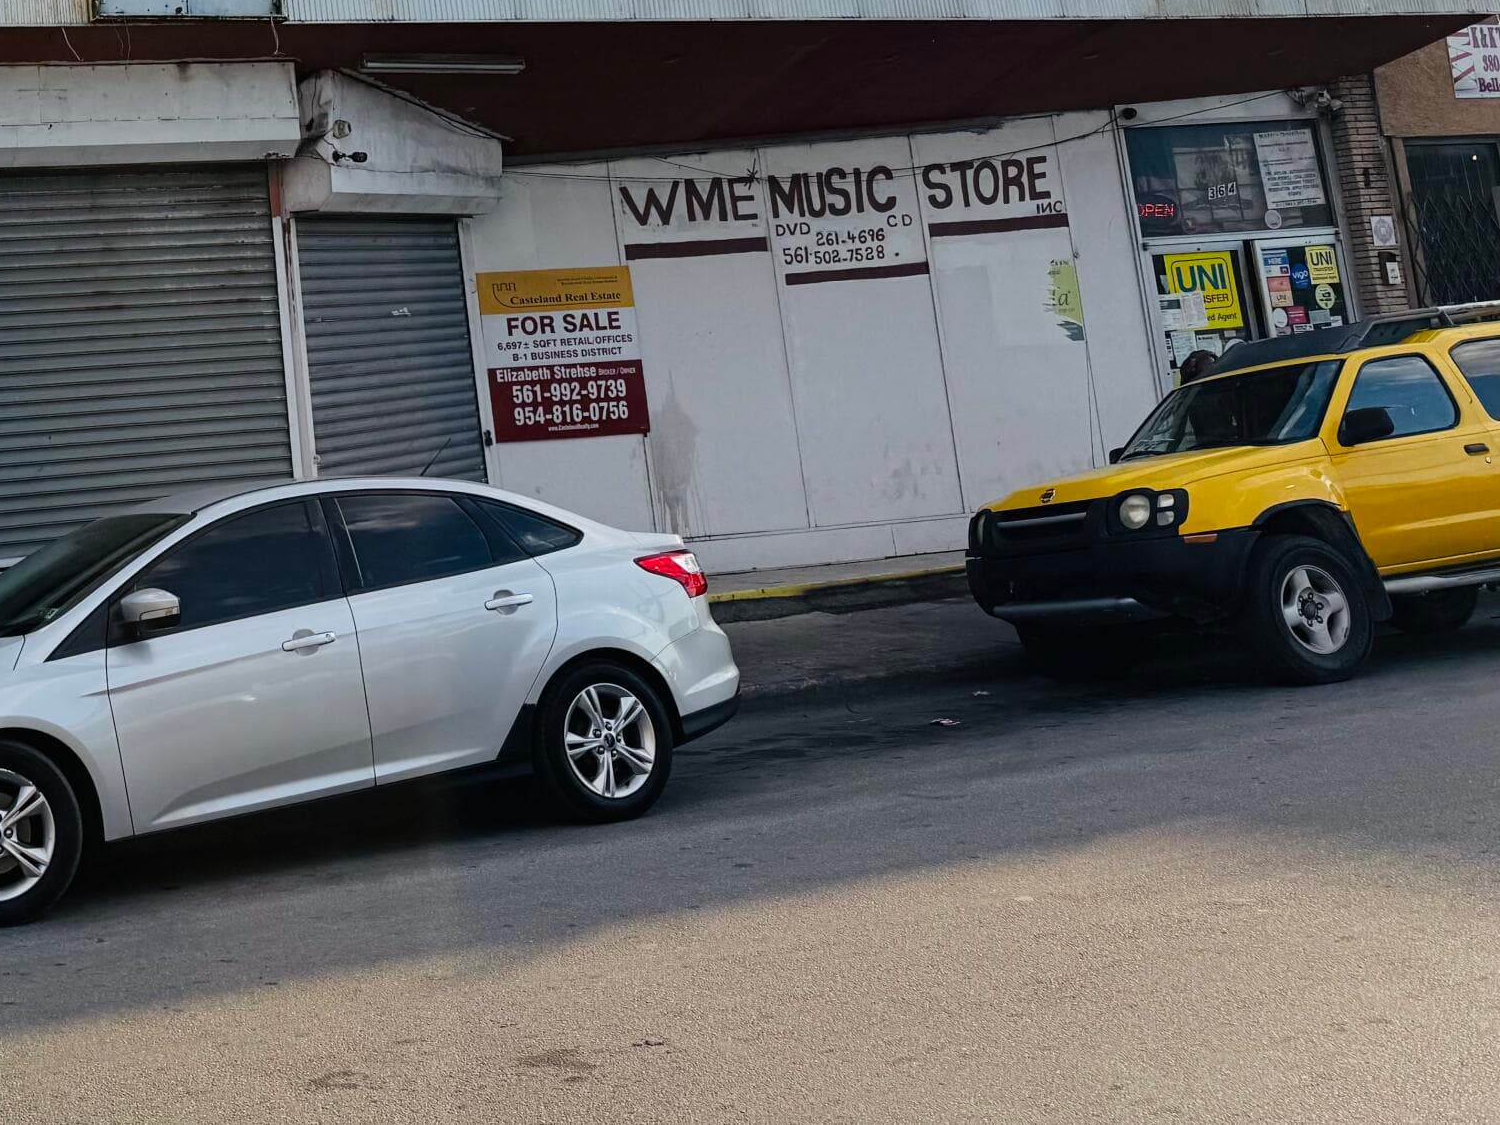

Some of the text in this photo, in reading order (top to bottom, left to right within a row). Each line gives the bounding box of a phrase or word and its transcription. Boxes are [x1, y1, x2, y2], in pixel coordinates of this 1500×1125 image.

[1478, 77, 1500, 93] Bell
[619, 155, 1051, 226] WME MUSIC STORE
[1208, 182, 1236, 200] 364
[1036, 200, 1063, 215] INC
[775, 221, 811, 236] DVD
[1310, 251, 1333, 266] UNI
[1175, 263, 1227, 293] UNI
[510, 291, 621, 305] Casteland Real Estate
[506, 311, 622, 336] FOR SALE
[533, 338, 557, 348] SQFT
[512, 346, 622, 362] B-1 BUSINESS DISTRICT
[496, 365, 551, 382] Elizabeth
[553, 364, 597, 379] Strehse
[512, 379, 627, 404] 561-992-9739
[514, 400, 629, 426] 954-816-0756
